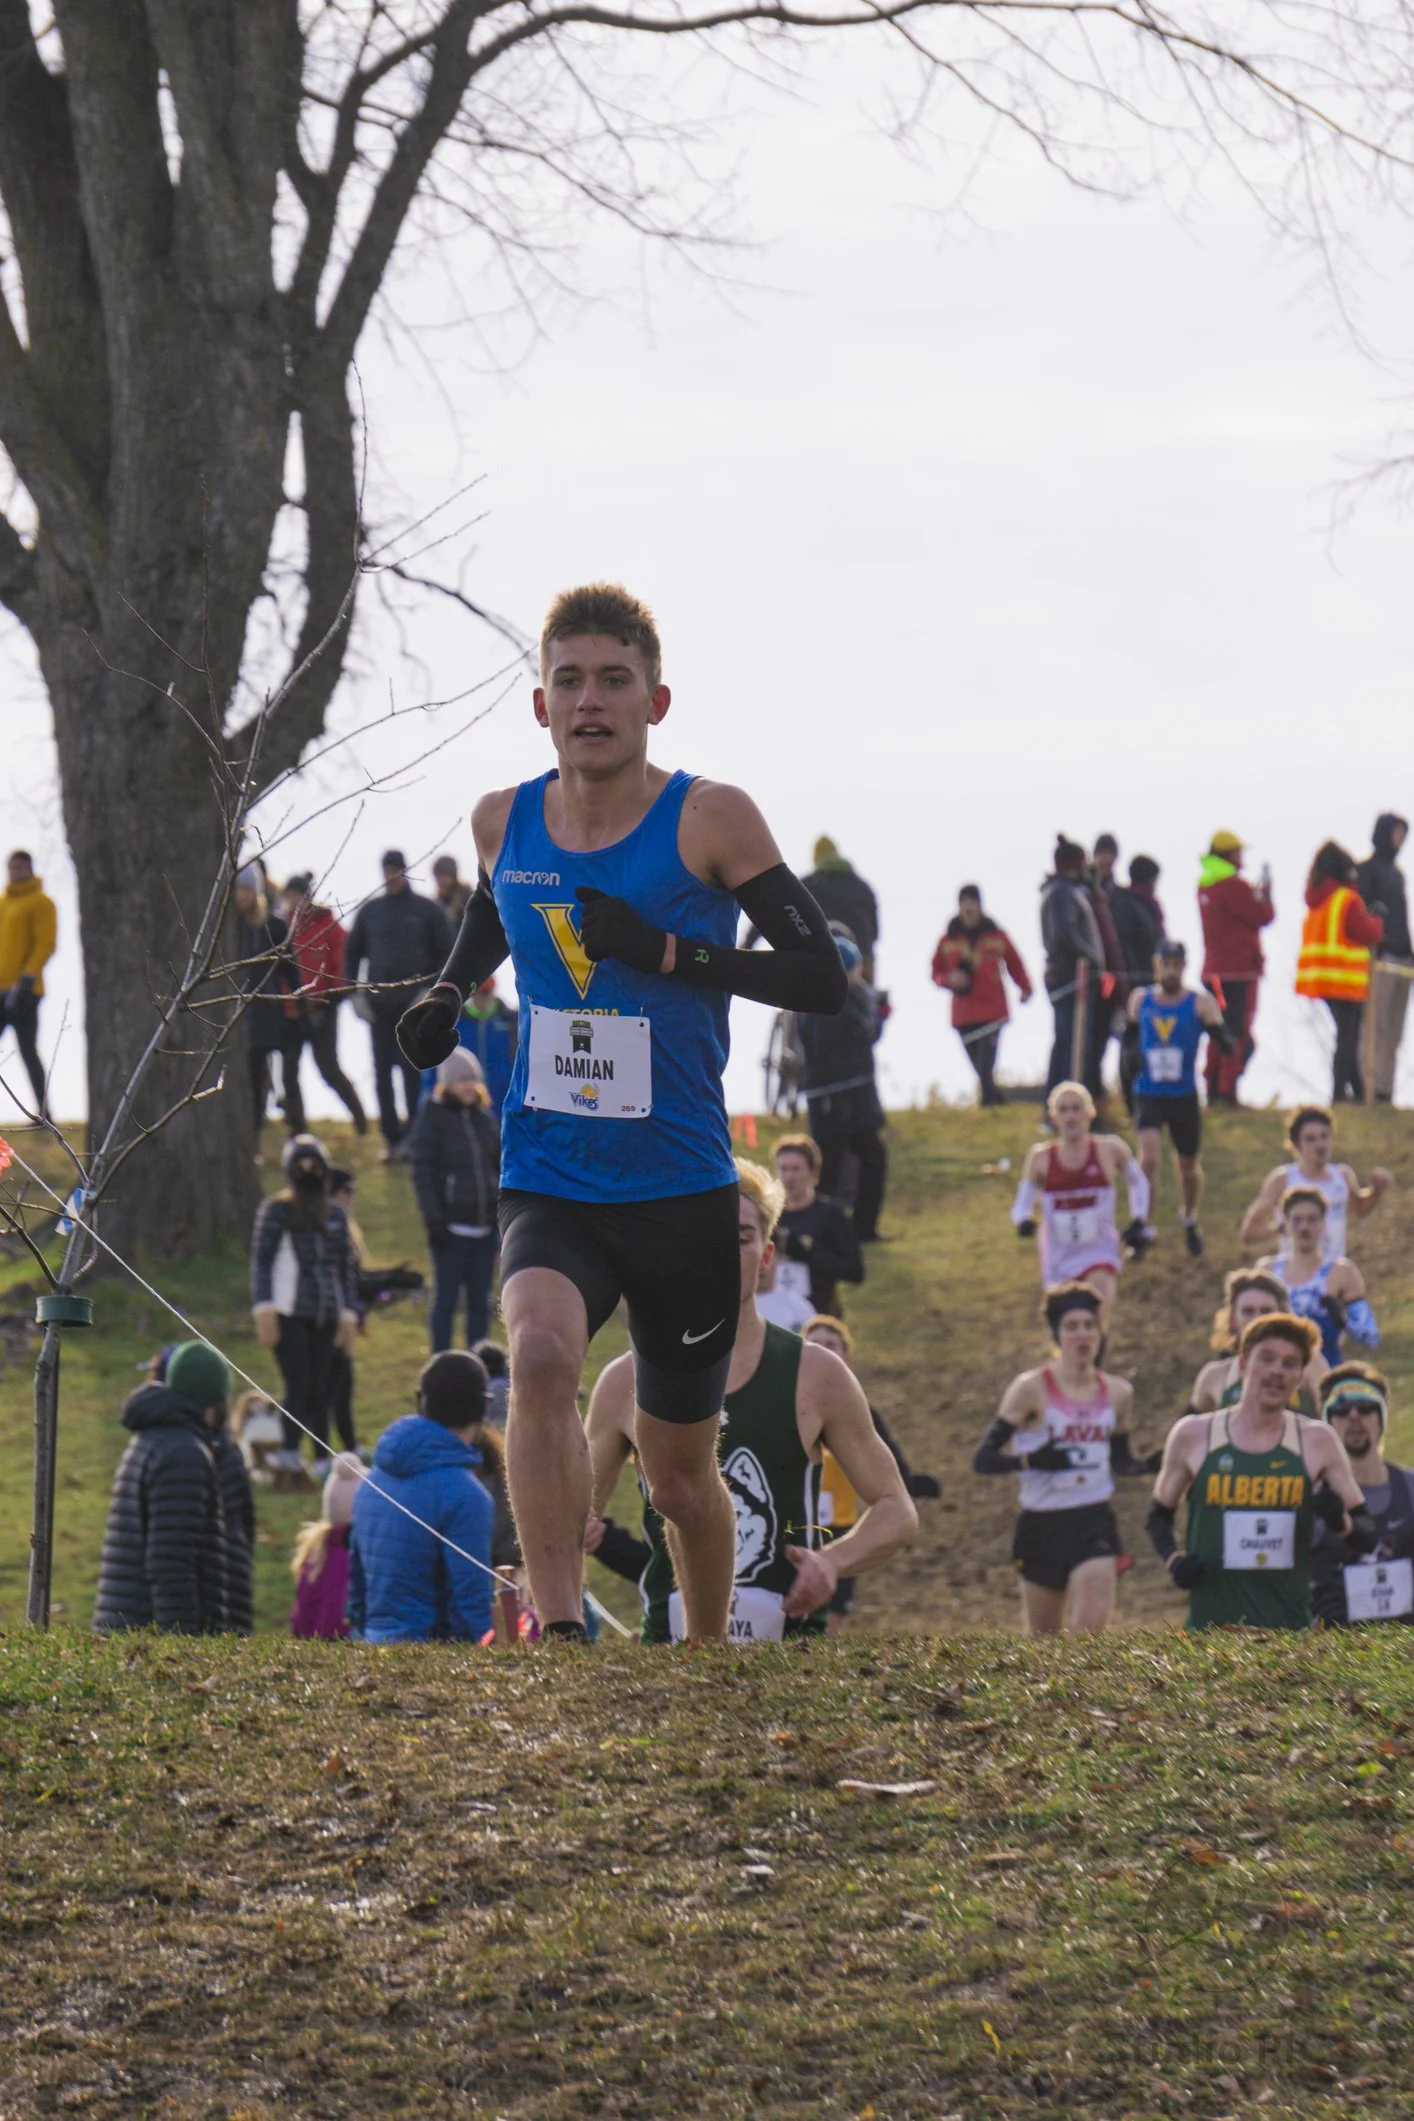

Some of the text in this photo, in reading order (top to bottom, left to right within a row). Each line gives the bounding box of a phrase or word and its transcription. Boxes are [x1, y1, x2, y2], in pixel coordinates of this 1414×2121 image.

[501, 869, 560, 886] macron
[530, 903, 598, 1001] V
[554, 1054, 614, 1081] DAMIAN
[1047, 1423, 1108, 1443] LAVA
[1205, 1473, 1304, 1506] ALBERTA
[728, 1620, 753, 1638] AYA
